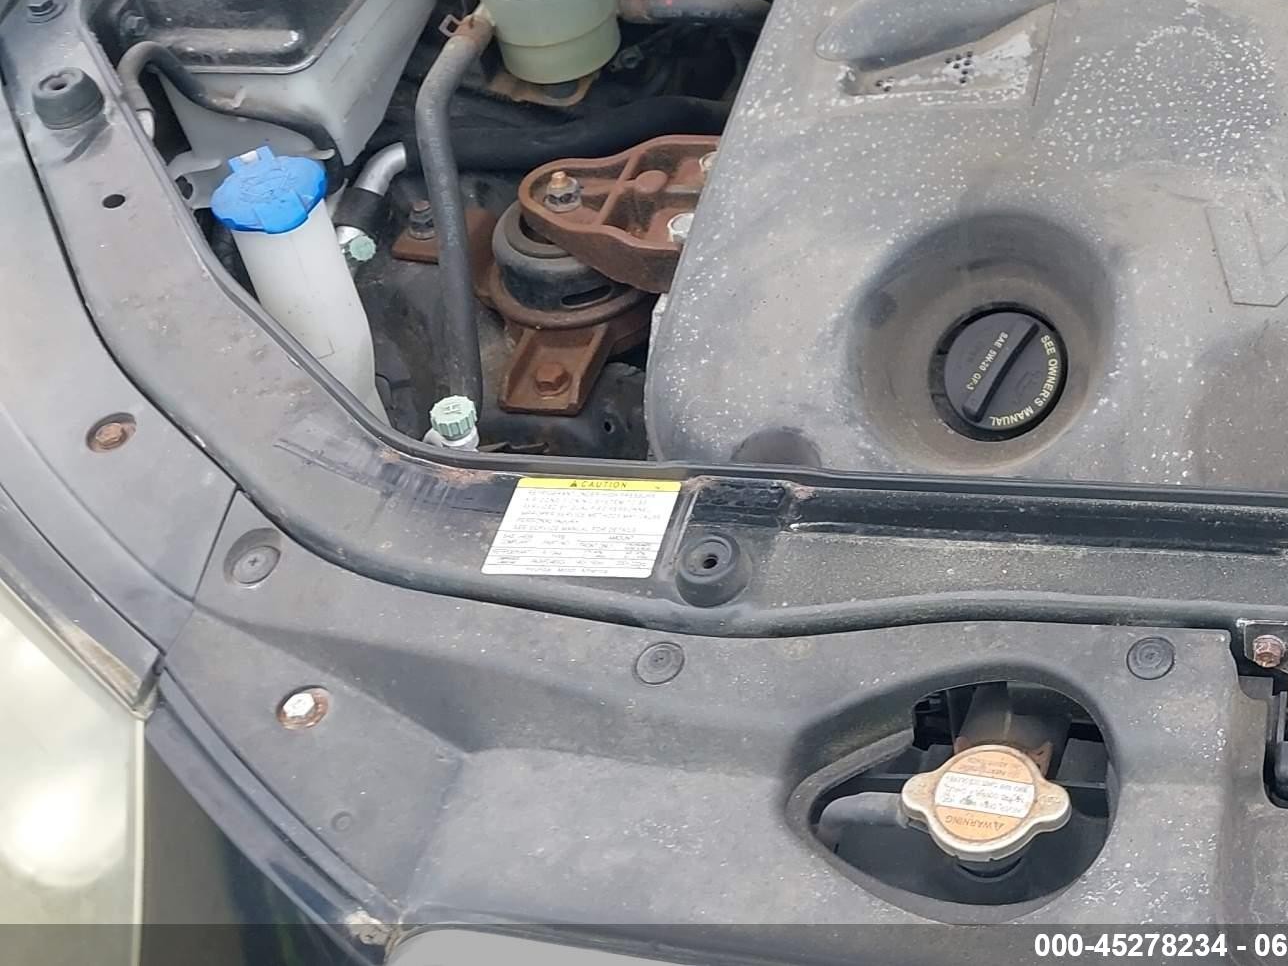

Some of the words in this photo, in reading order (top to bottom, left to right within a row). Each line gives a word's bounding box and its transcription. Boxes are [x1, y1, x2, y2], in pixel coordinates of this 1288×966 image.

[994, 332, 1009, 348] SAE
[1041, 335, 1056, 355] SEE
[979, 349, 997, 371] 5W-20
[966, 373, 982, 390] GF-3
[1034, 358, 1058, 407] OWNER'S
[989, 406, 1034, 426] MANUAL
[581, 481, 627, 489] CAUTION
[945, 815, 993, 830] WARNING
